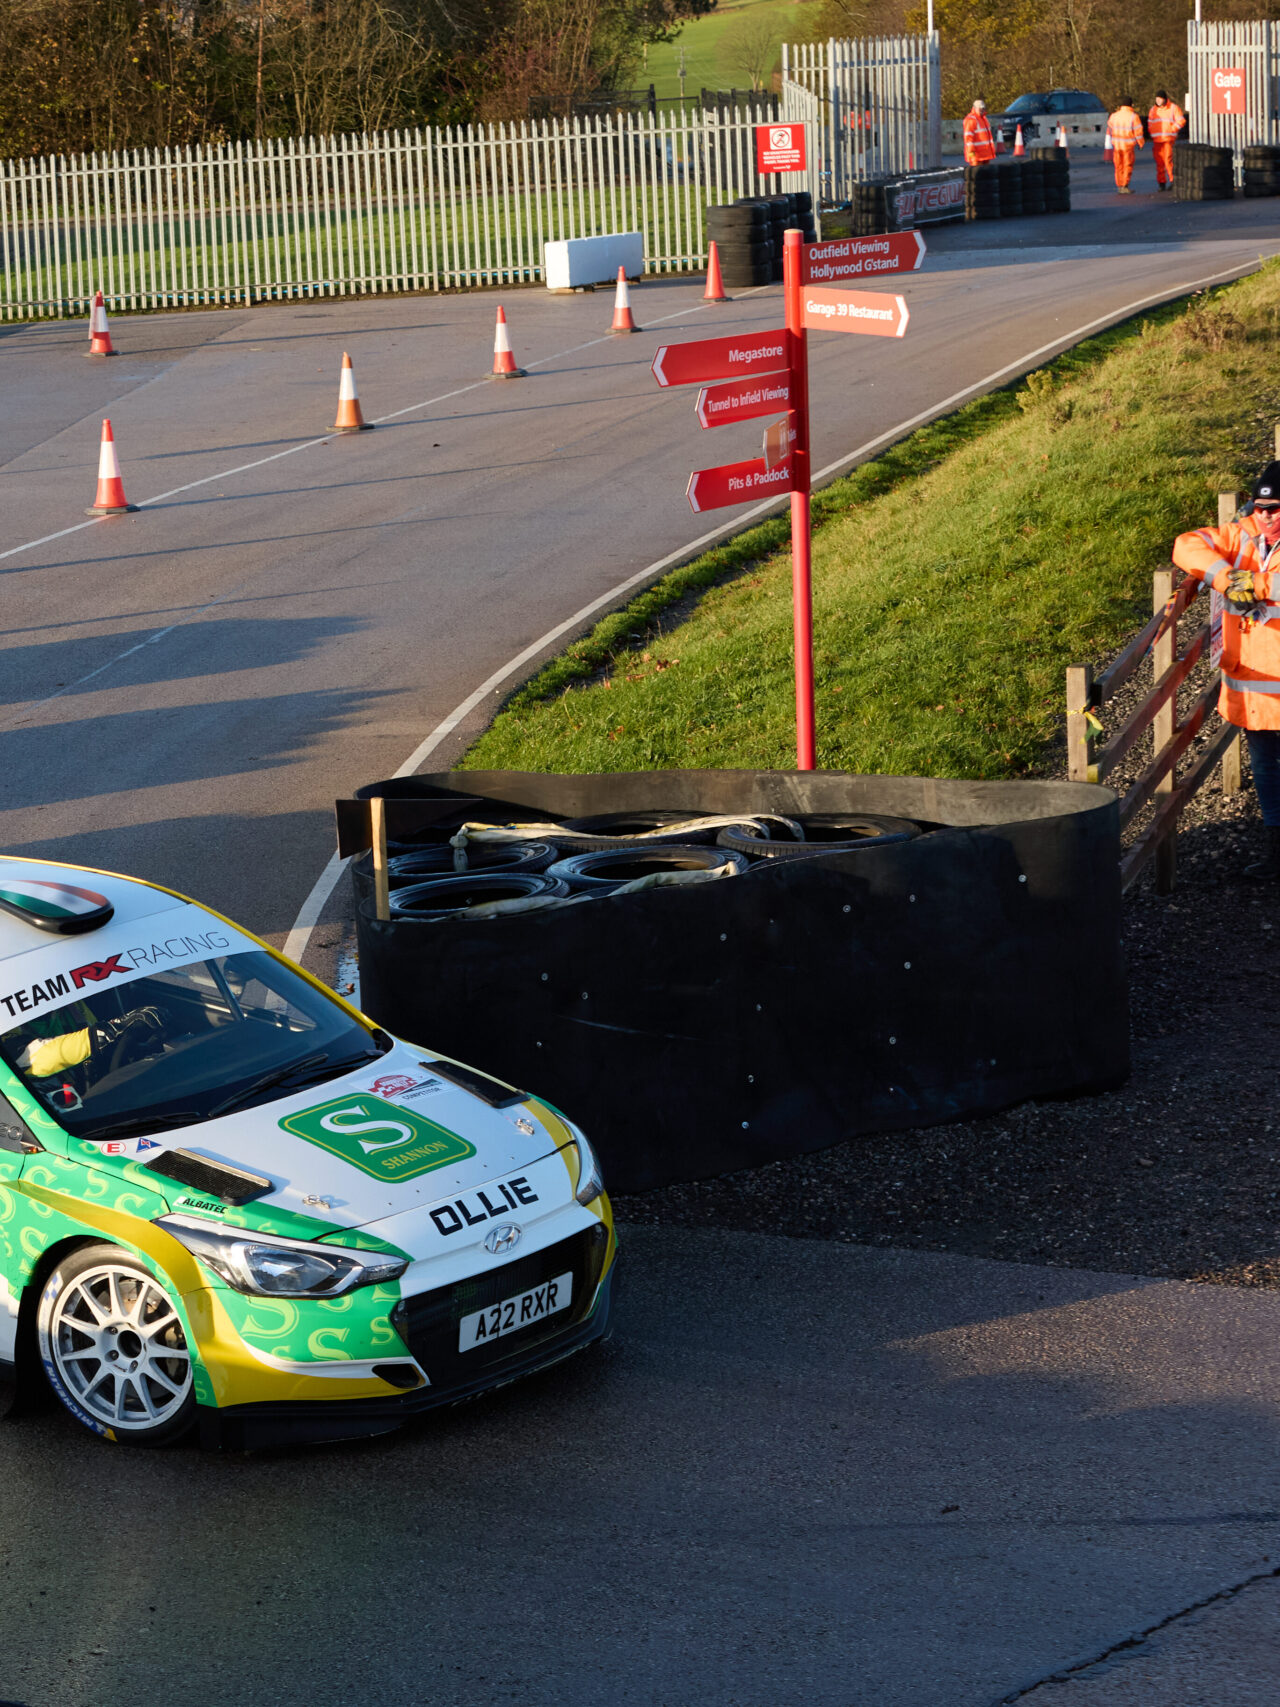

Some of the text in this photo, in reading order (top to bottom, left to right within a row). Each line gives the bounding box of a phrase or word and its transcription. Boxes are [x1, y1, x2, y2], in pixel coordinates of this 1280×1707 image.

[1214, 71, 1242, 88] Gate
[1223, 90, 1232, 111] 1
[809, 240, 890, 260] Outfield Viewing
[810, 255, 899, 279] Hollywood G'stand
[806, 300, 893, 321] Garage 39 Restaurant
[728, 345, 784, 363] Megastore
[708, 385, 789, 413] Tunnel to Infield Viewing
[728, 467, 790, 491] Pits & Paddock
[0, 974, 71, 1018] TEAM
[126, 931, 230, 969] RACING
[106, 1143, 121, 1154] E
[380, 1140, 449, 1170] SHANNON
[182, 1197, 229, 1214] ALBATEC
[428, 1176, 540, 1237] OLLIE
[475, 1282, 559, 1342] A22 RXR
[45, 1364, 95, 1427] MICHELIN
